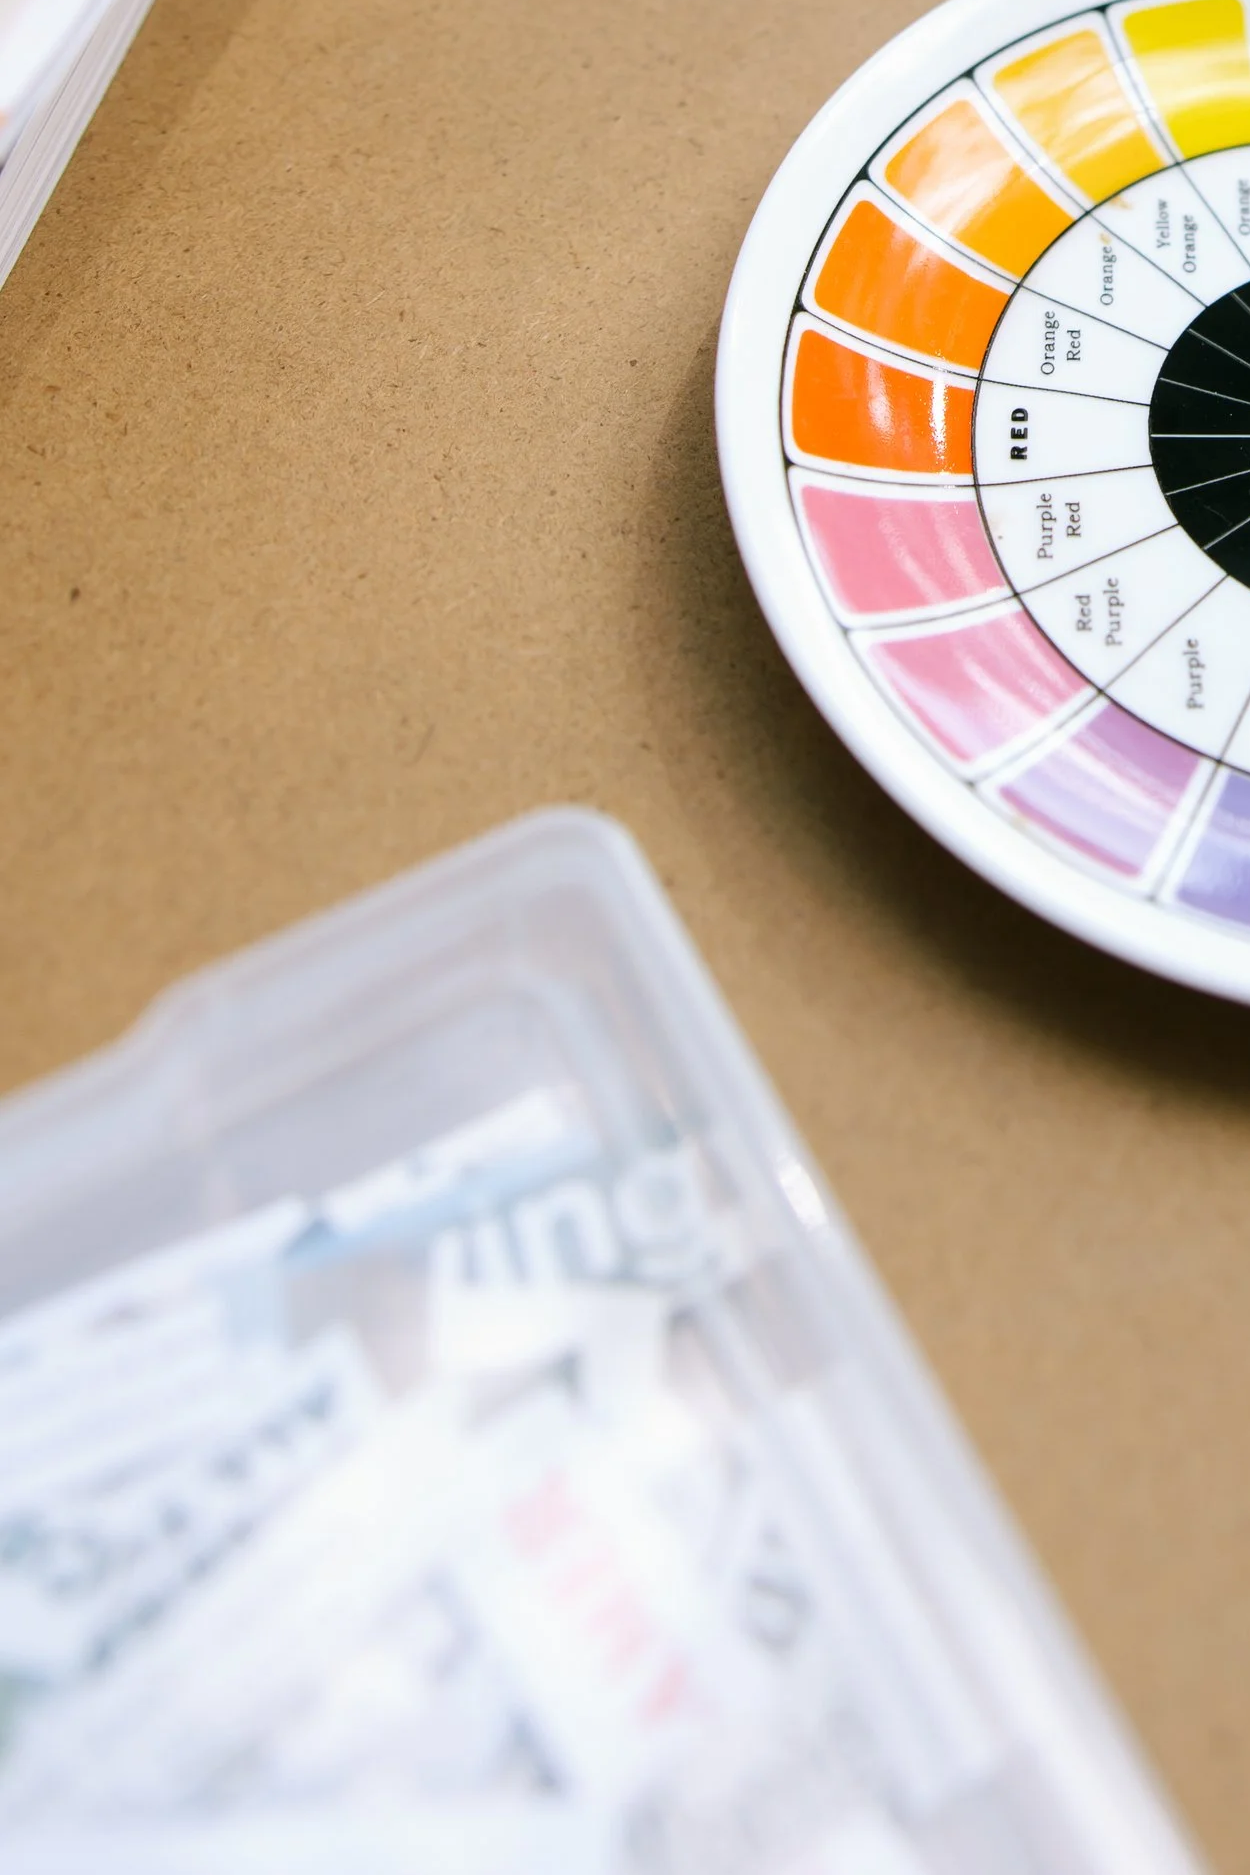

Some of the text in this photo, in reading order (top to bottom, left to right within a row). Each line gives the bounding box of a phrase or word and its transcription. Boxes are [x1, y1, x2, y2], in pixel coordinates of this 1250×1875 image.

[1156, 198, 1171, 249] Yellow
[1183, 214, 1199, 273] Orange
[1101, 245, 1117, 306] Orange
[1040, 310, 1061, 376] Orange
[1066, 328, 1081, 362] Red
[1010, 407, 1028, 461] RED
[1037, 492, 1054, 560] Purple
[1066, 501, 1082, 538] Red
[1076, 594, 1092, 633] Red
[1104, 577, 1123, 647] Purple
[1184, 638, 1204, 711] Purple
